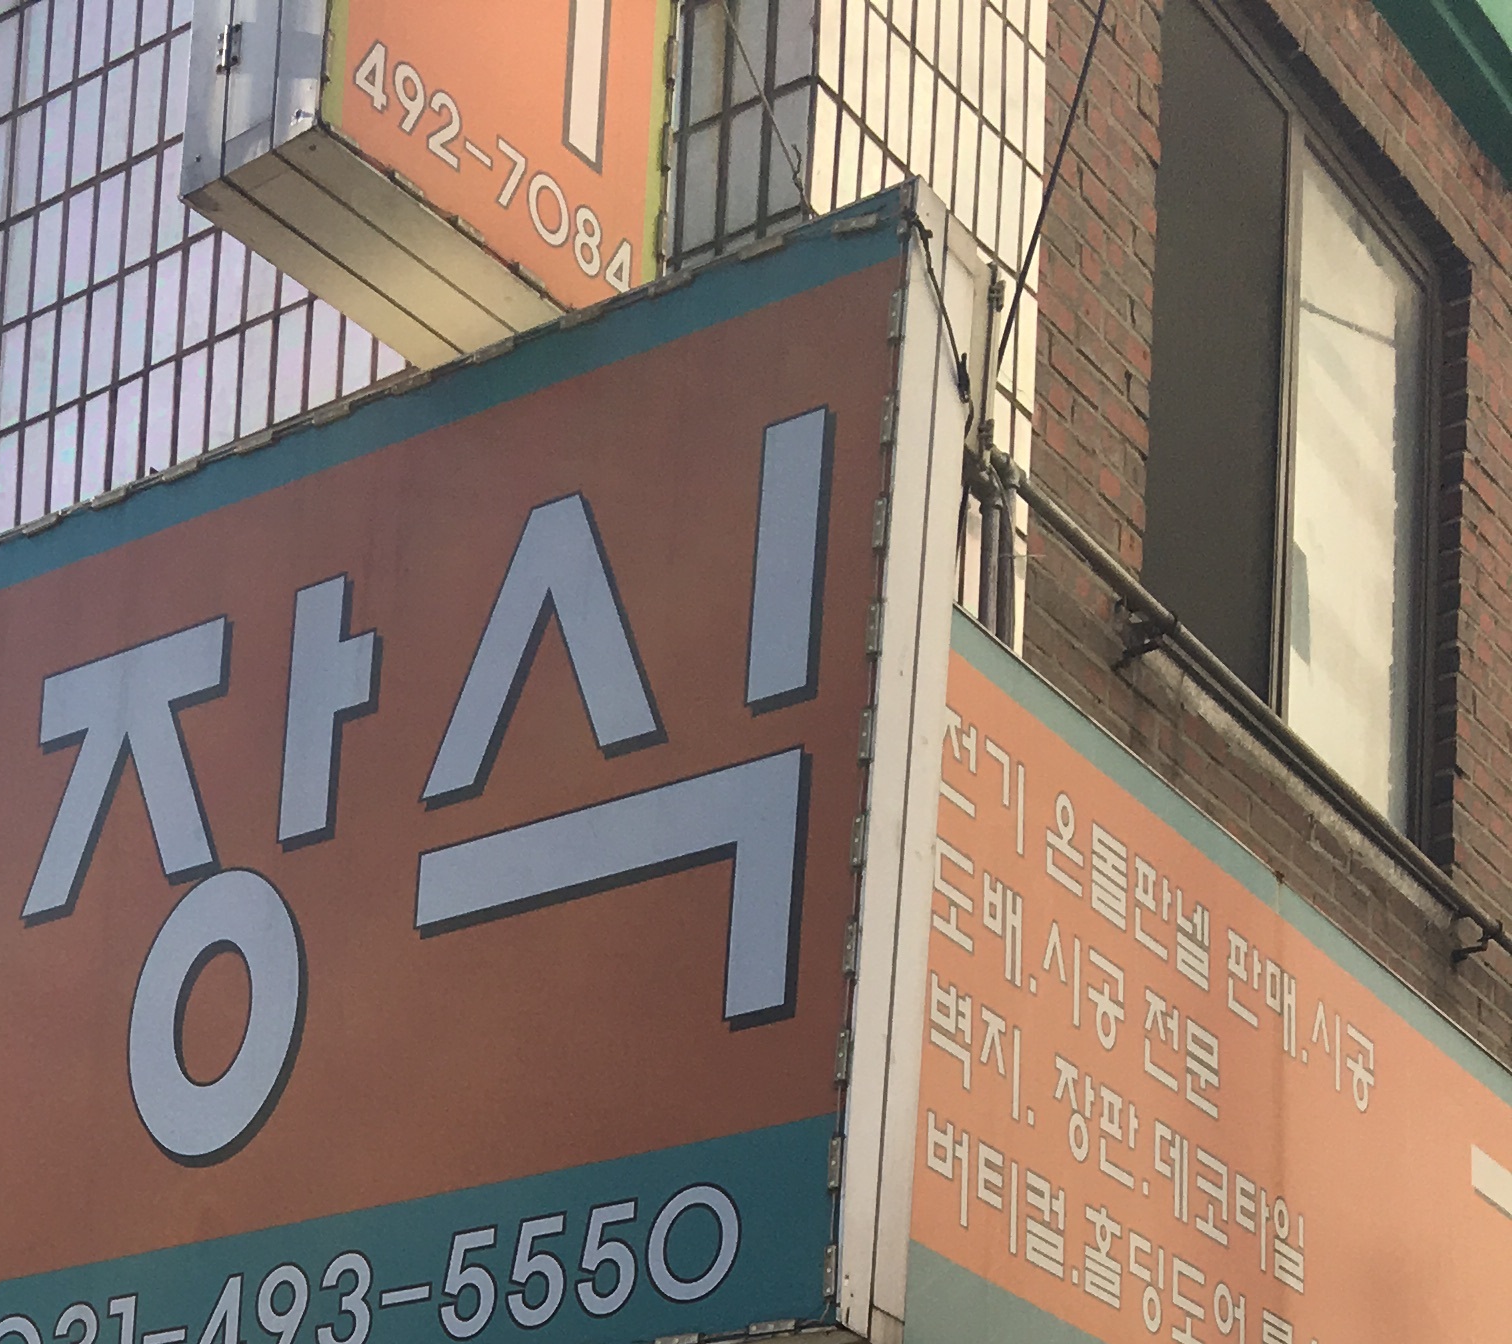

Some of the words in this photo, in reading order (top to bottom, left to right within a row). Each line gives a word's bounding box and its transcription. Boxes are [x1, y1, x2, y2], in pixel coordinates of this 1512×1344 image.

[353, 40, 633, 293] 492-7084
[931, 837, 1126, 1051] 도배.시공
[1143, 986, 1220, 1120] 전문
[941, 705, 1027, 856] 전기
[1044, 790, 1214, 991] 온돌판넬
[1224, 927, 1378, 1113] 판매.시공
